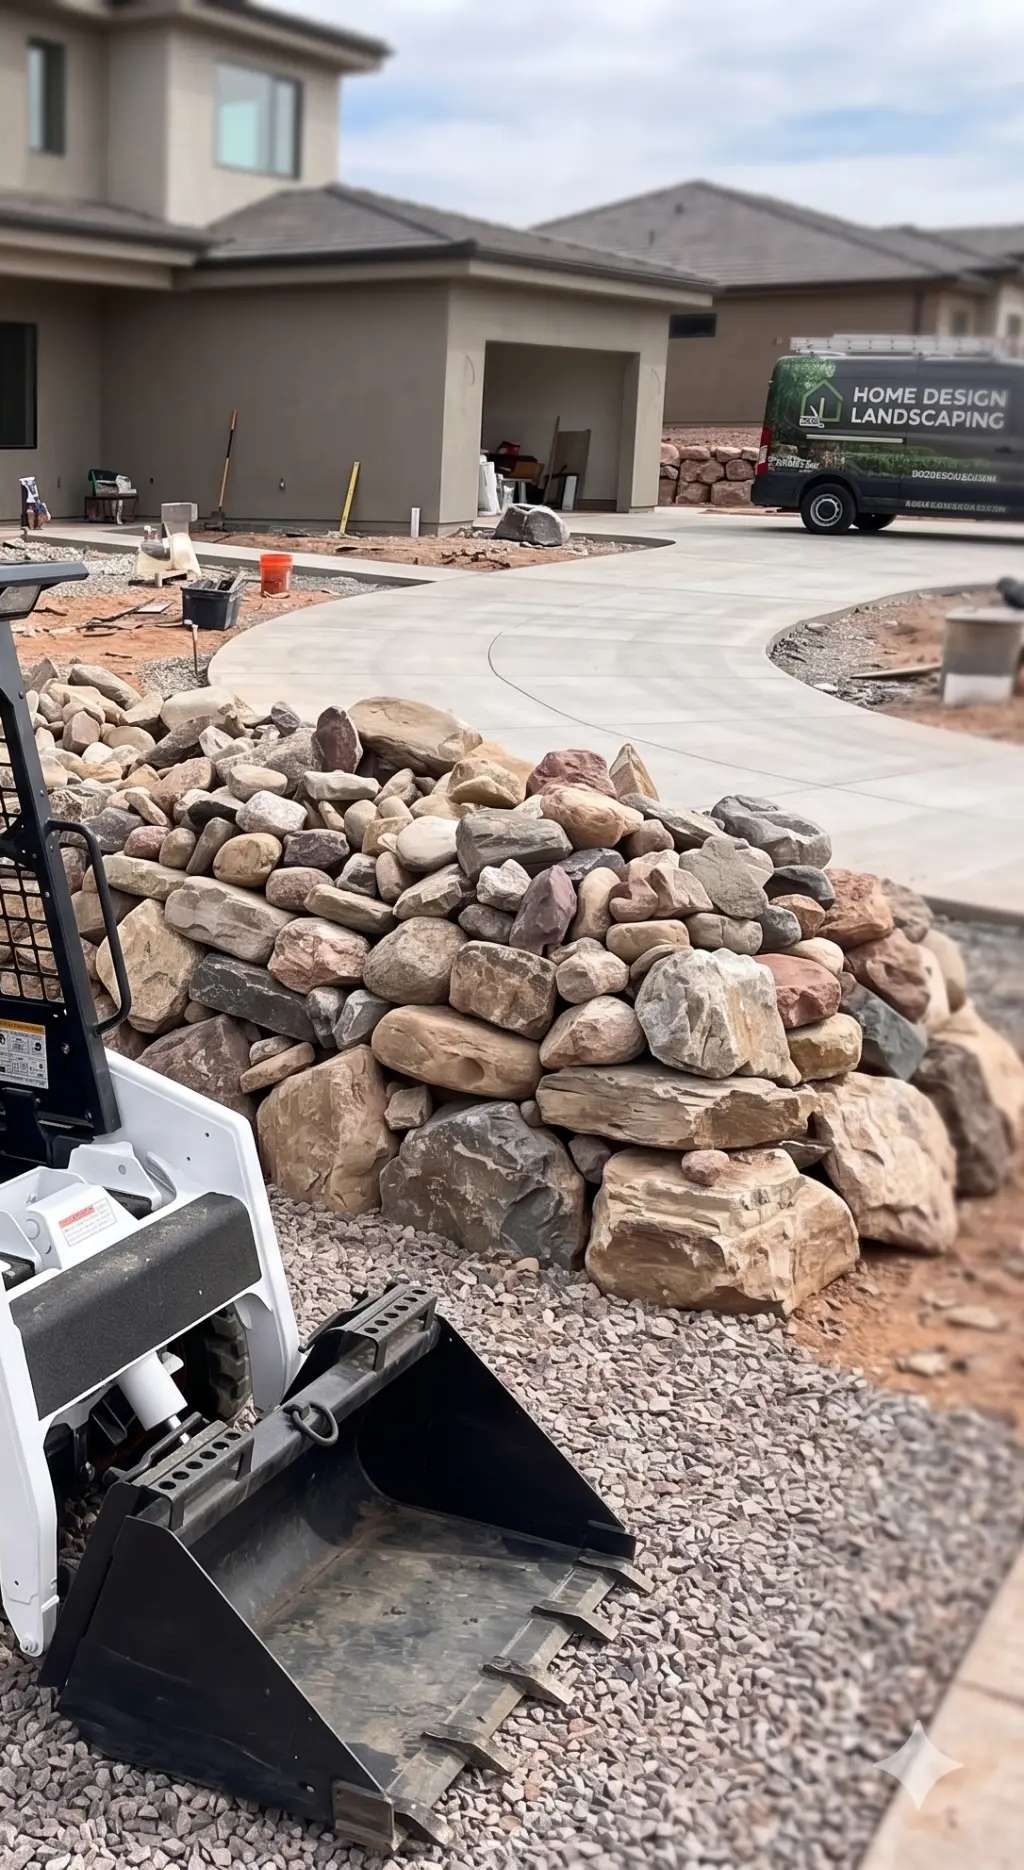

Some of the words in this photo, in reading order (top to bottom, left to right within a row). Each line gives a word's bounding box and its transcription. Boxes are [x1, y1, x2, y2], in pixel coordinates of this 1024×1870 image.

[853, 386, 916, 404] HOME
[923, 388, 1008, 408] DESIGN
[850, 407, 1005, 429] LANDSCAPING
